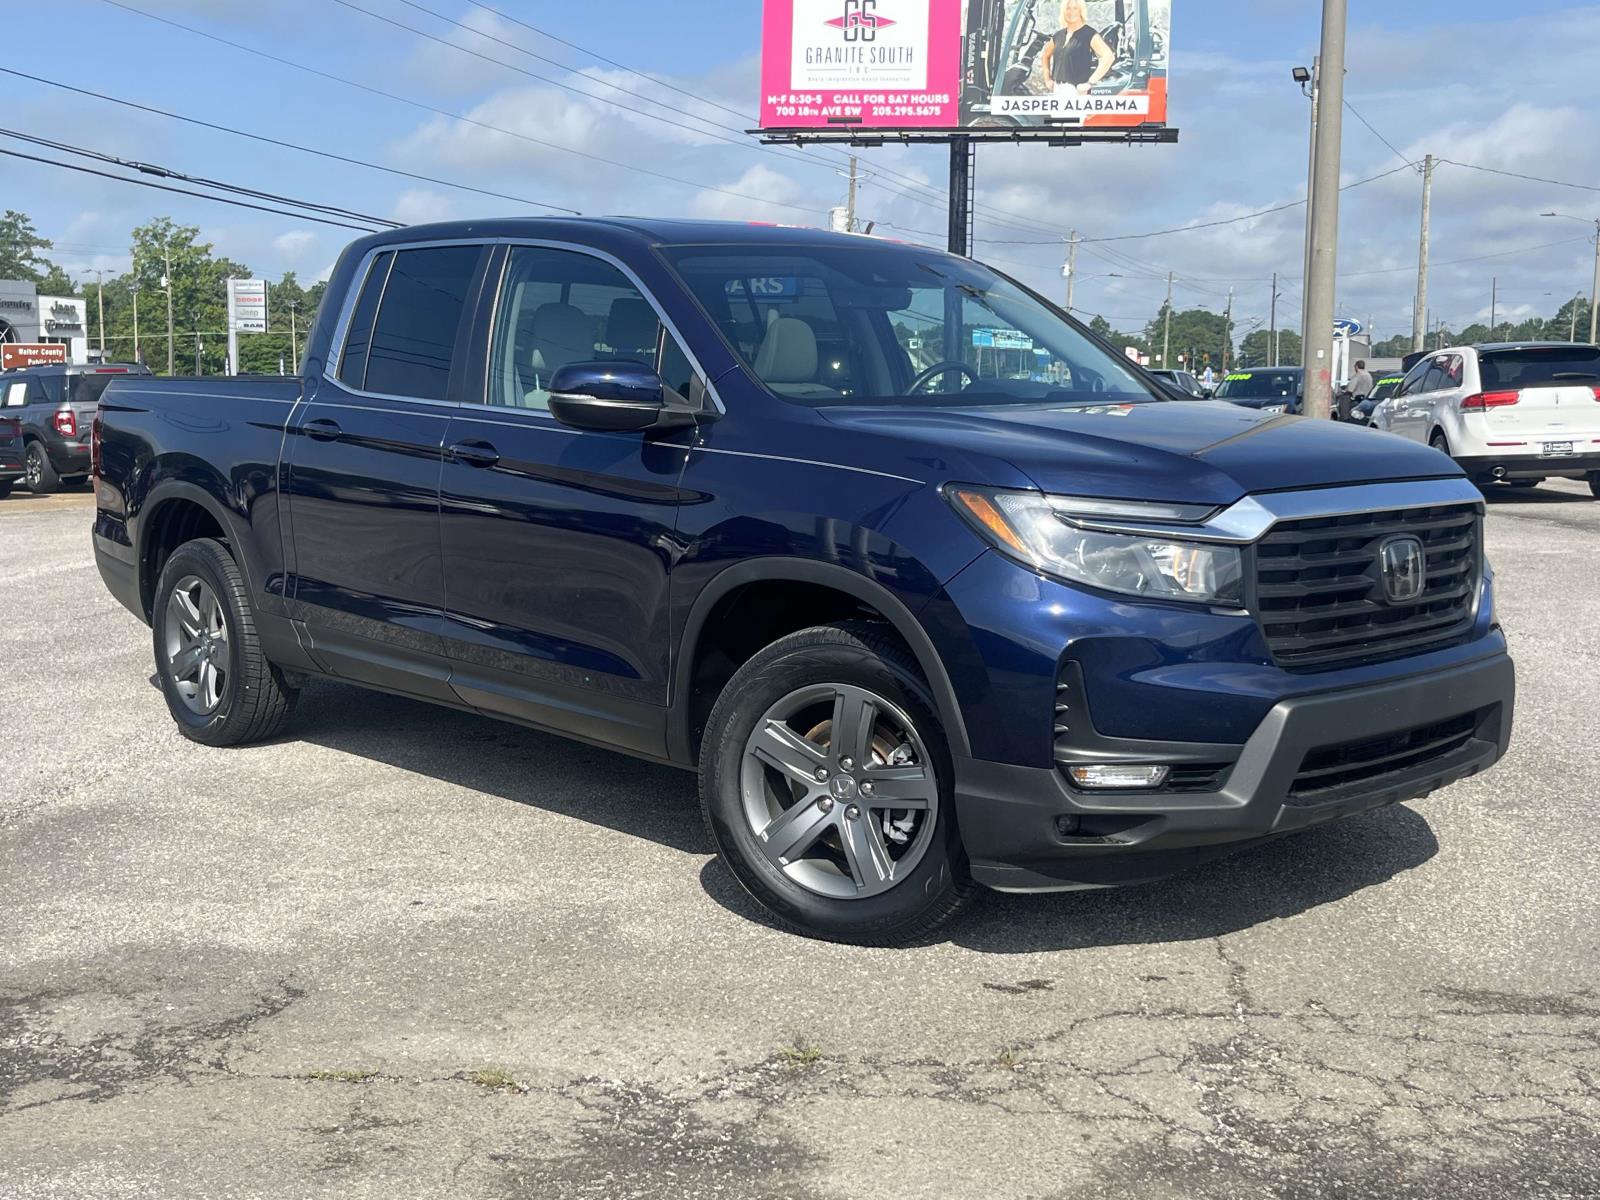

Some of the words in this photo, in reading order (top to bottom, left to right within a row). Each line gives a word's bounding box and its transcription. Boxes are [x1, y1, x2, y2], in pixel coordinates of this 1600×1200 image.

[805, 46, 864, 64] GRANITE
[870, 46, 913, 64] SOUTH
[767, 95, 787, 104] M-F
[789, 95, 823, 104] 8:30-5
[833, 95, 861, 104] CALL
[863, 95, 886, 104] FOR
[888, 95, 908, 104] SAT
[910, 94, 950, 104] HOURS
[1001, 99, 1059, 111] JASPER
[1064, 99, 1138, 111] ALABAMA
[775, 106, 796, 116] 700
[821, 106, 842, 116] AVE
[844, 106, 862, 116] SW
[872, 106, 942, 116] 205.295.5675
[725, 278, 784, 294] ARS
[50, 300, 77, 313] Jeep
[18, 348, 39, 356] Walker
[40, 348, 64, 357] County
